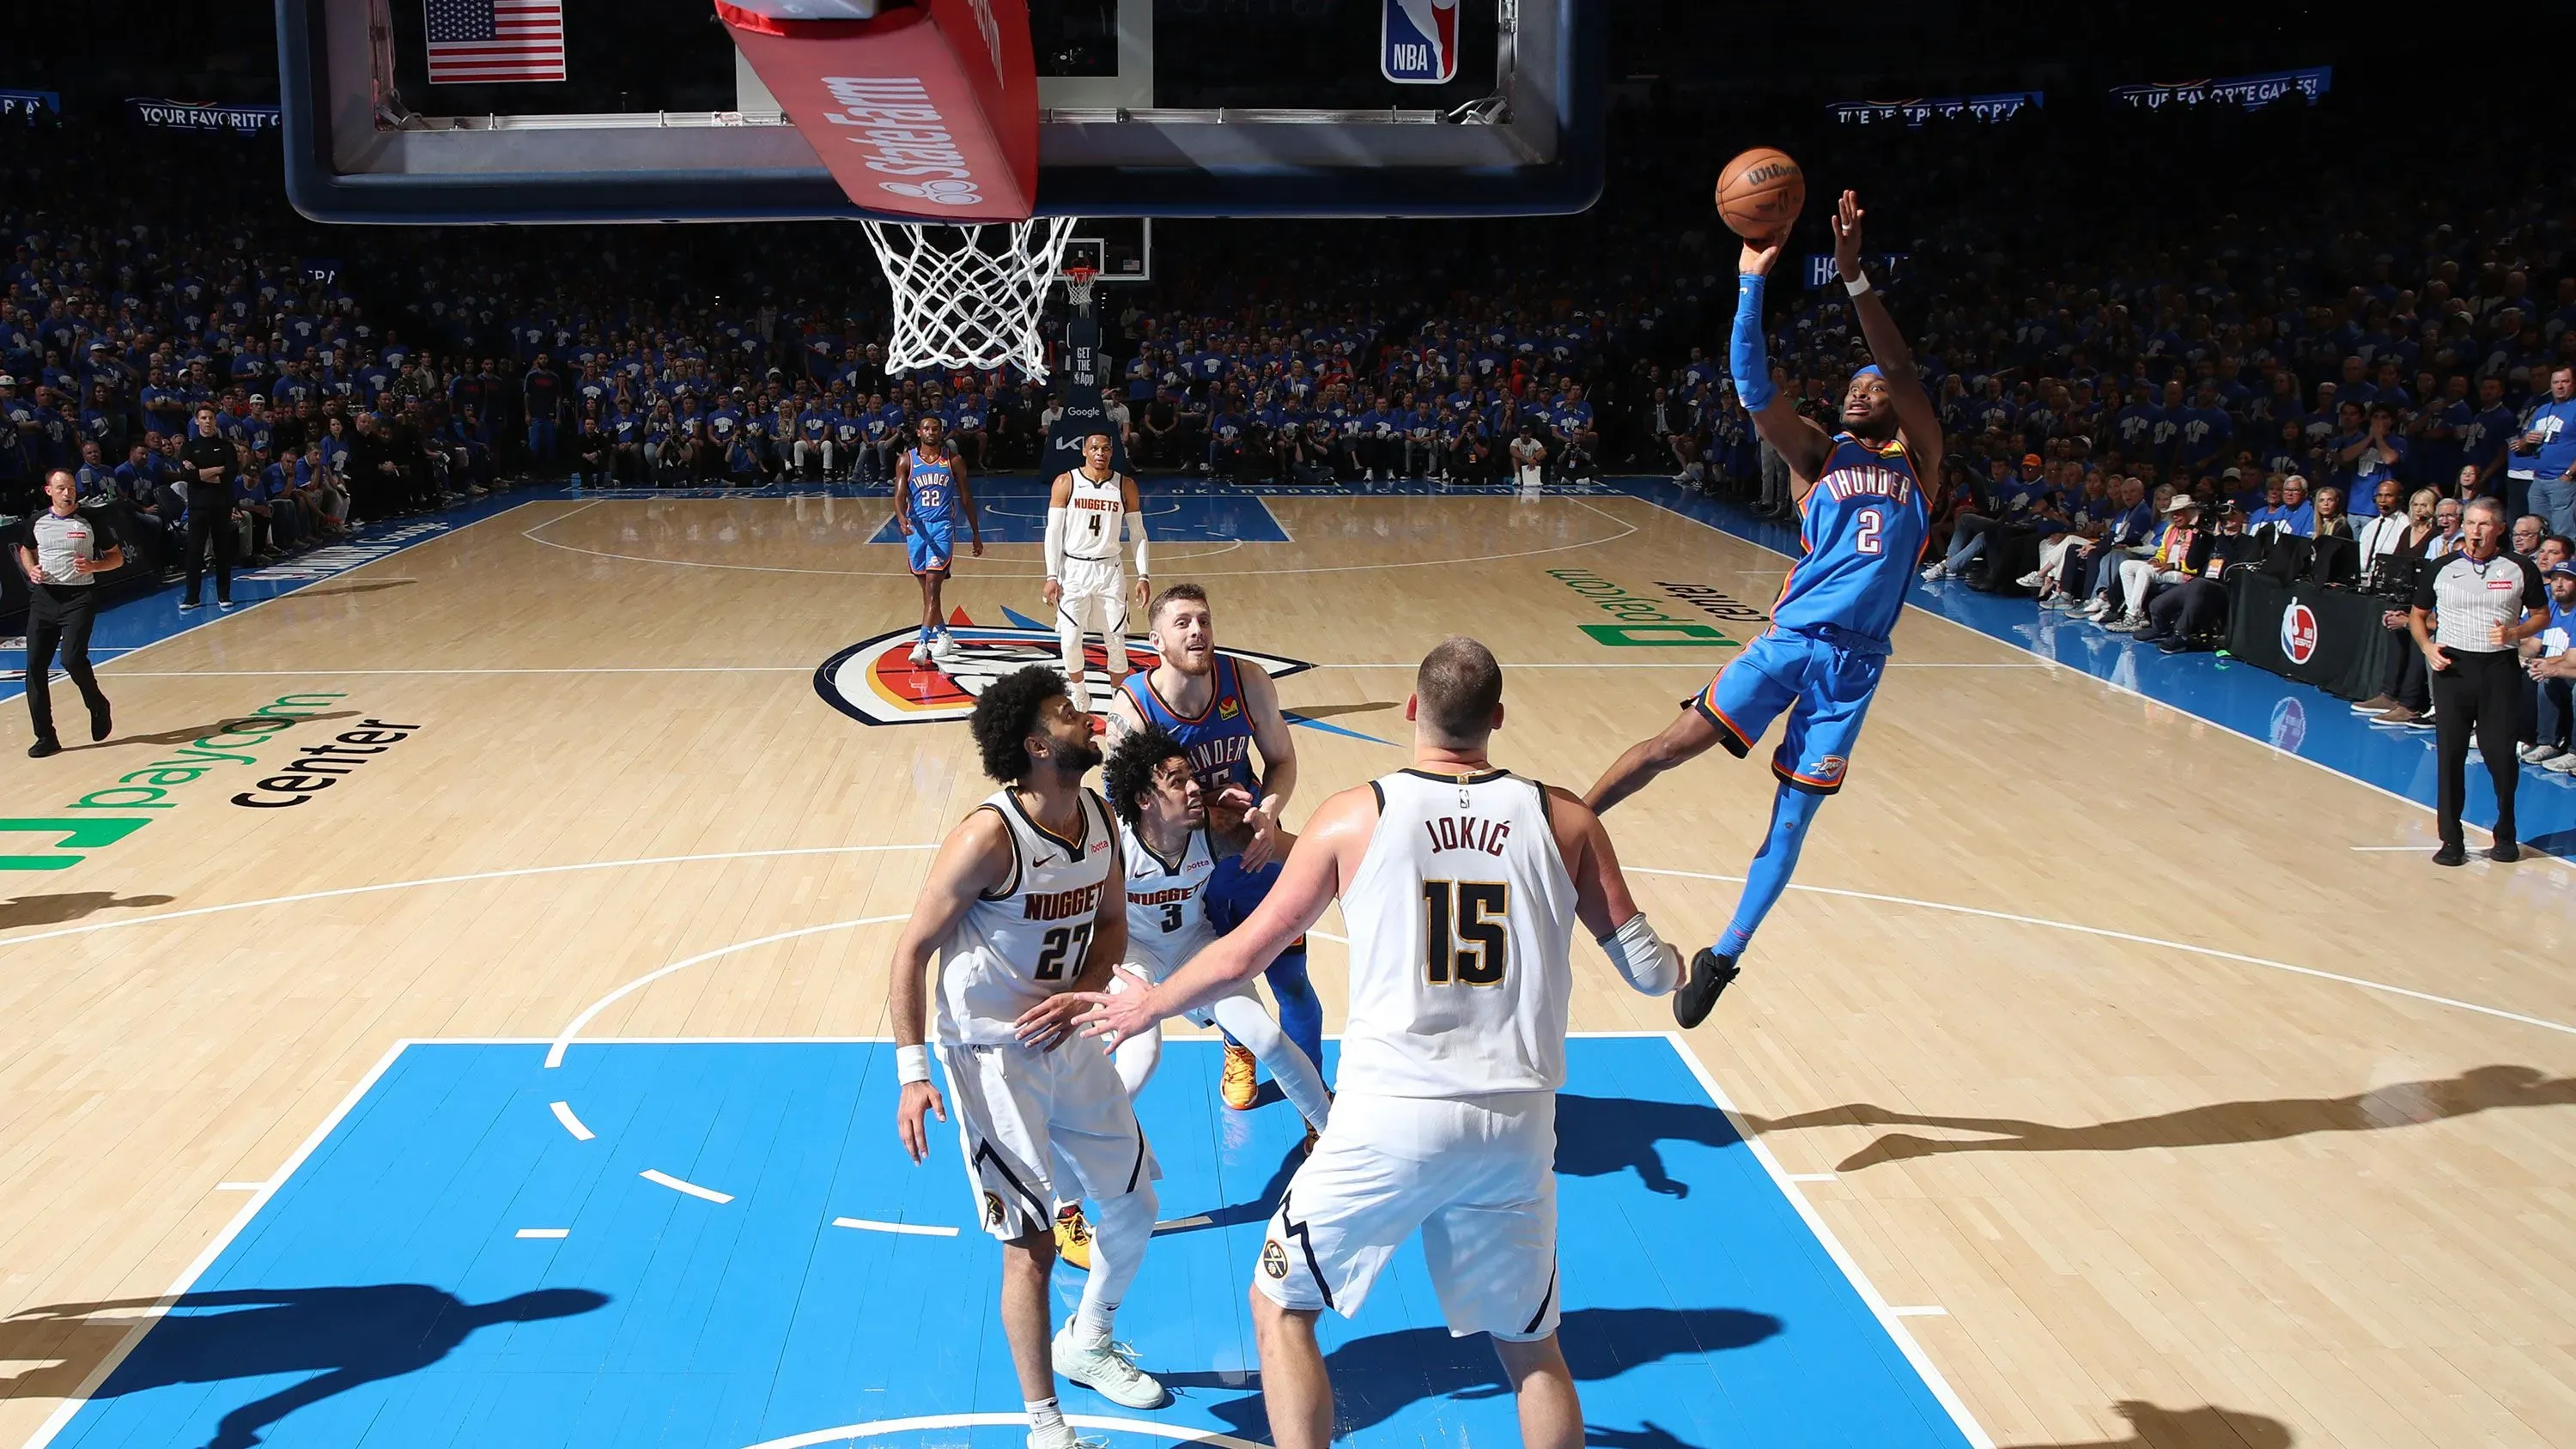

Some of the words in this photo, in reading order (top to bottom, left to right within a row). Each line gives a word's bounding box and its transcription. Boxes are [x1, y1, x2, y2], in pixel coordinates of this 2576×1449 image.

[1394, 44, 1428, 70] NBA
[139, 106, 186, 124] YOUR
[1077, 347, 1091, 359] GET
[1077, 359, 1091, 371] THE
[1080, 372, 1094, 386] App
[1067, 406, 1100, 418] Google
[912, 472, 950, 489] THUNDER
[1820, 464, 1911, 506] THUNDER
[921, 489, 940, 506] 22
[1074, 498, 1120, 512] NUGGETS
[1089, 514, 1102, 537] 4
[1856, 508, 1883, 555] 2
[1546, 569, 1696, 621] paycom
[1651, 581, 1771, 621] center
[64, 693, 349, 809] paycom
[230, 718, 422, 809] center
[1090, 840, 1109, 854] ibotta
[1425, 816, 1511, 857] JOKIĆ
[1159, 903, 1183, 934] 3
[1423, 879, 1510, 986] 15
[1035, 920, 1093, 980] 27
